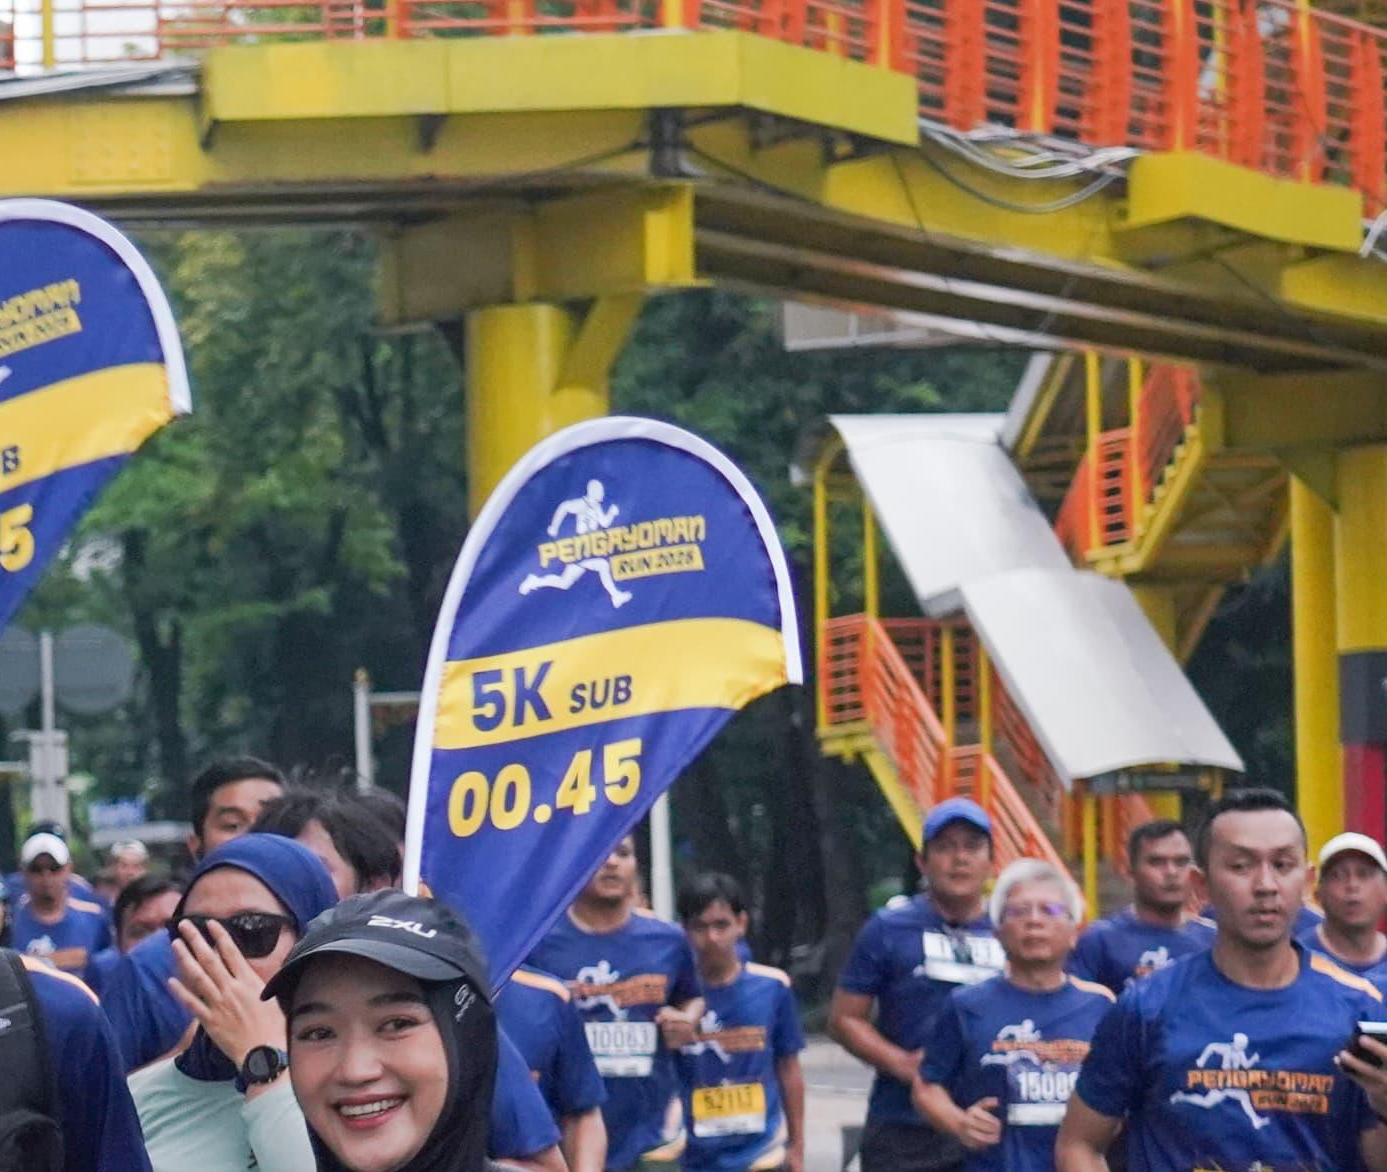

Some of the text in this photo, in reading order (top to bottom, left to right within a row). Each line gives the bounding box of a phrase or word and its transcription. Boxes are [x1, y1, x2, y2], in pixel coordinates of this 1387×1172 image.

[538, 515, 706, 569] PENGAYOMAN
[617, 557, 653, 576] RUN
[470, 660, 633, 732] 5K SUB
[447, 737, 643, 838] 00.45
[367, 914, 438, 939] 2XU
